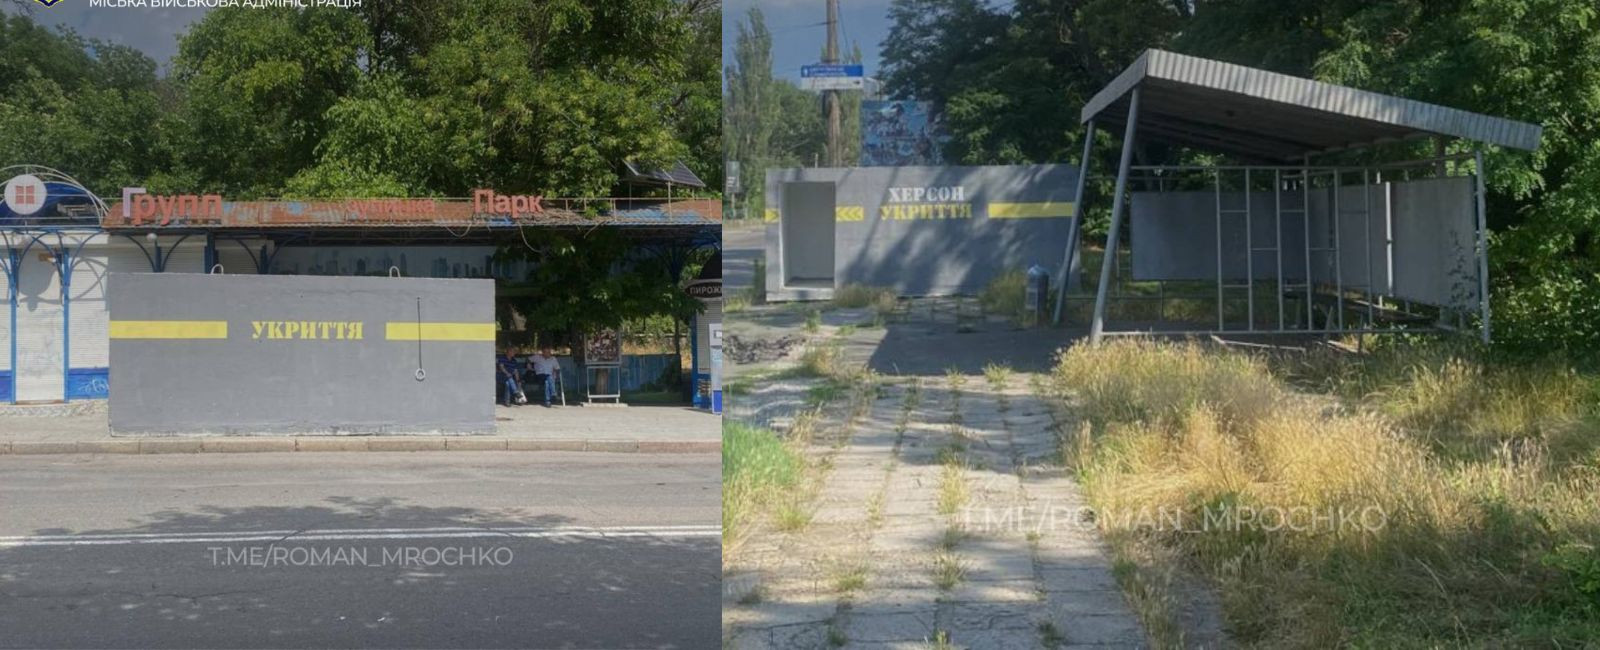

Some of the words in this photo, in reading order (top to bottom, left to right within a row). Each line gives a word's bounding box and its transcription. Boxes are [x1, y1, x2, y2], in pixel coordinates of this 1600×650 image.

[473, 188, 544, 217] Парк
[888, 186, 965, 202] ХЕРСОН
[122, 187, 222, 226] Групп
[881, 203, 973, 220] УКРИТТЯ
[251, 321, 363, 340] УКРИТТЯ
